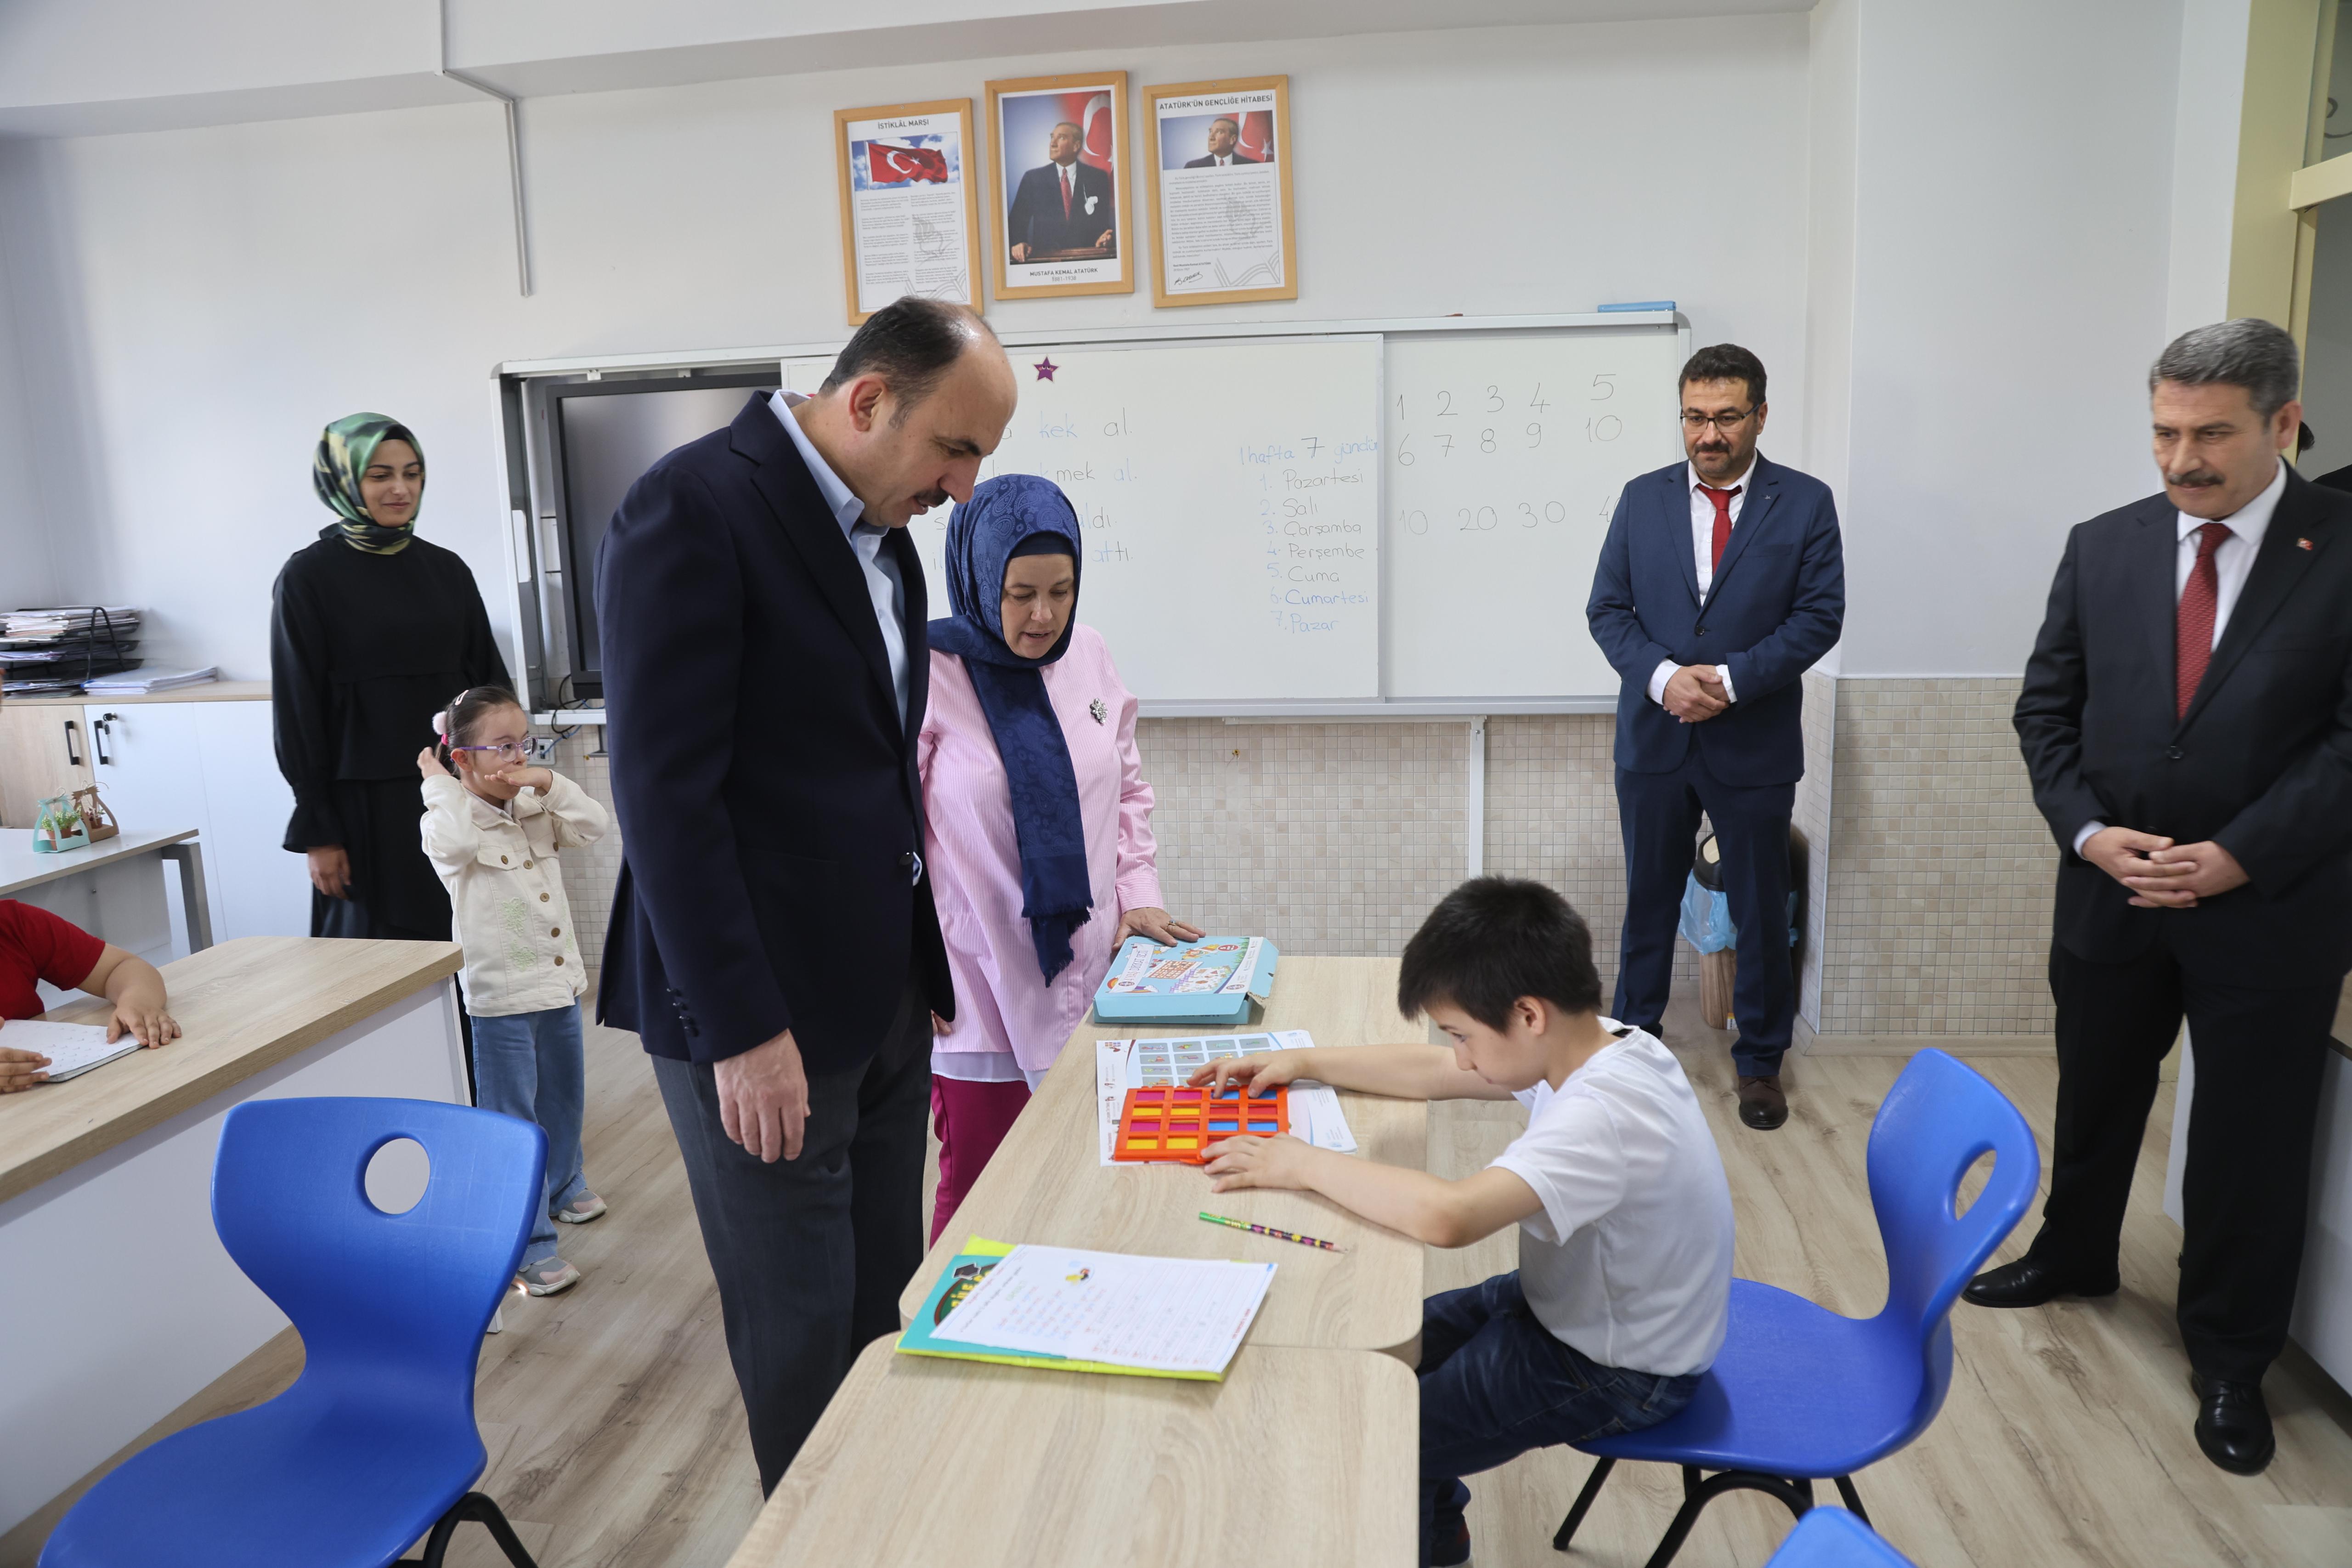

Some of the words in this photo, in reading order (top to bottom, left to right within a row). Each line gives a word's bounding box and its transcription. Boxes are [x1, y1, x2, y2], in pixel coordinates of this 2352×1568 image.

[1159, 99, 1203, 110] ATATÜRK'ÜN
[1204, 96, 1239, 107] GENÇLİĞE
[1241, 94, 1273, 104] HİTABESİ
[1397, 394, 1405, 420] 1
[1437, 391, 1459, 417] 2
[1487, 385, 1504, 413] 3
[1530, 382, 1551, 413] 4
[1590, 374, 1617, 401] 5
[1039, 410, 1078, 438] kek
[1300, 437, 1325, 459] 7
[1398, 433, 1415, 466] 6
[1433, 434, 1455, 458] 7
[1481, 428, 1497, 454] 8
[1526, 422, 1542, 449] 9
[1586, 414, 1623, 442] 10
[1283, 467, 1363, 491] Pazartesi
[1260, 499, 1276, 515] 2.
[1283, 496, 1318, 517] Salı
[1262, 520, 1278, 534] 3.
[1284, 519, 1362, 537] Çarşamba
[1399, 509, 1428, 535] 10
[1458, 506, 1498, 531] 20
[1519, 501, 1566, 528] 30
[1288, 542, 1365, 560] Perşembe
[1267, 562, 1283, 578] 5.
[1288, 566, 1340, 583] Cuma
[1285, 590, 1369, 606] Cumartesi
[1290, 612, 1340, 634] Pazar
